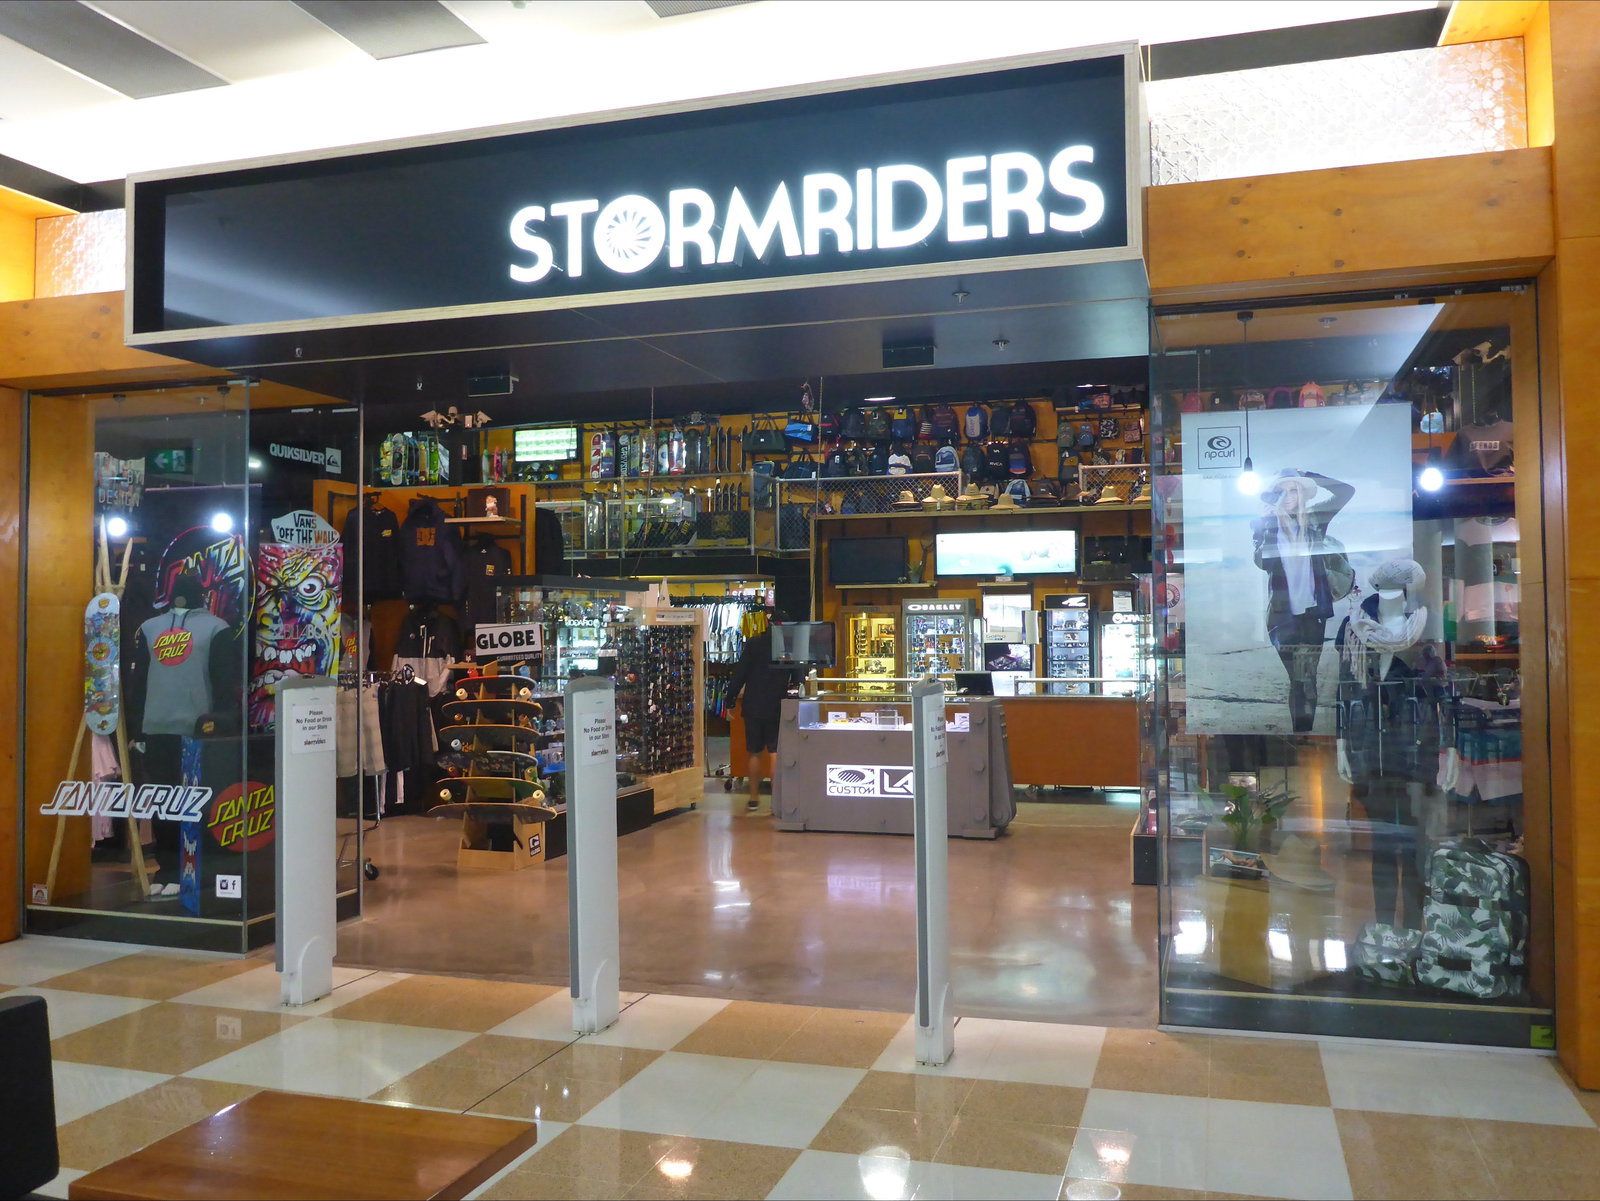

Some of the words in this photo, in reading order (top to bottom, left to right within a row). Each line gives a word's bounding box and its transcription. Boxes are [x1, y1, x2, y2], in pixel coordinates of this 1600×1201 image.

[510, 145, 1105, 283] STORMRIDERS
[270, 443, 325, 465] QUIKSILVER
[294, 513, 316, 529] VANS
[296, 529, 312, 544] THE
[153, 632, 192, 649] SANTA
[476, 630, 535, 649] GLOBE
[158, 643, 188, 661] CRUZ
[829, 785, 875, 794] CUSTOM
[40, 781, 135, 817] SANTA
[131, 784, 213, 822] CRUZ
[208, 784, 275, 828] SANTA
[220, 808, 275, 847] CRUZ
